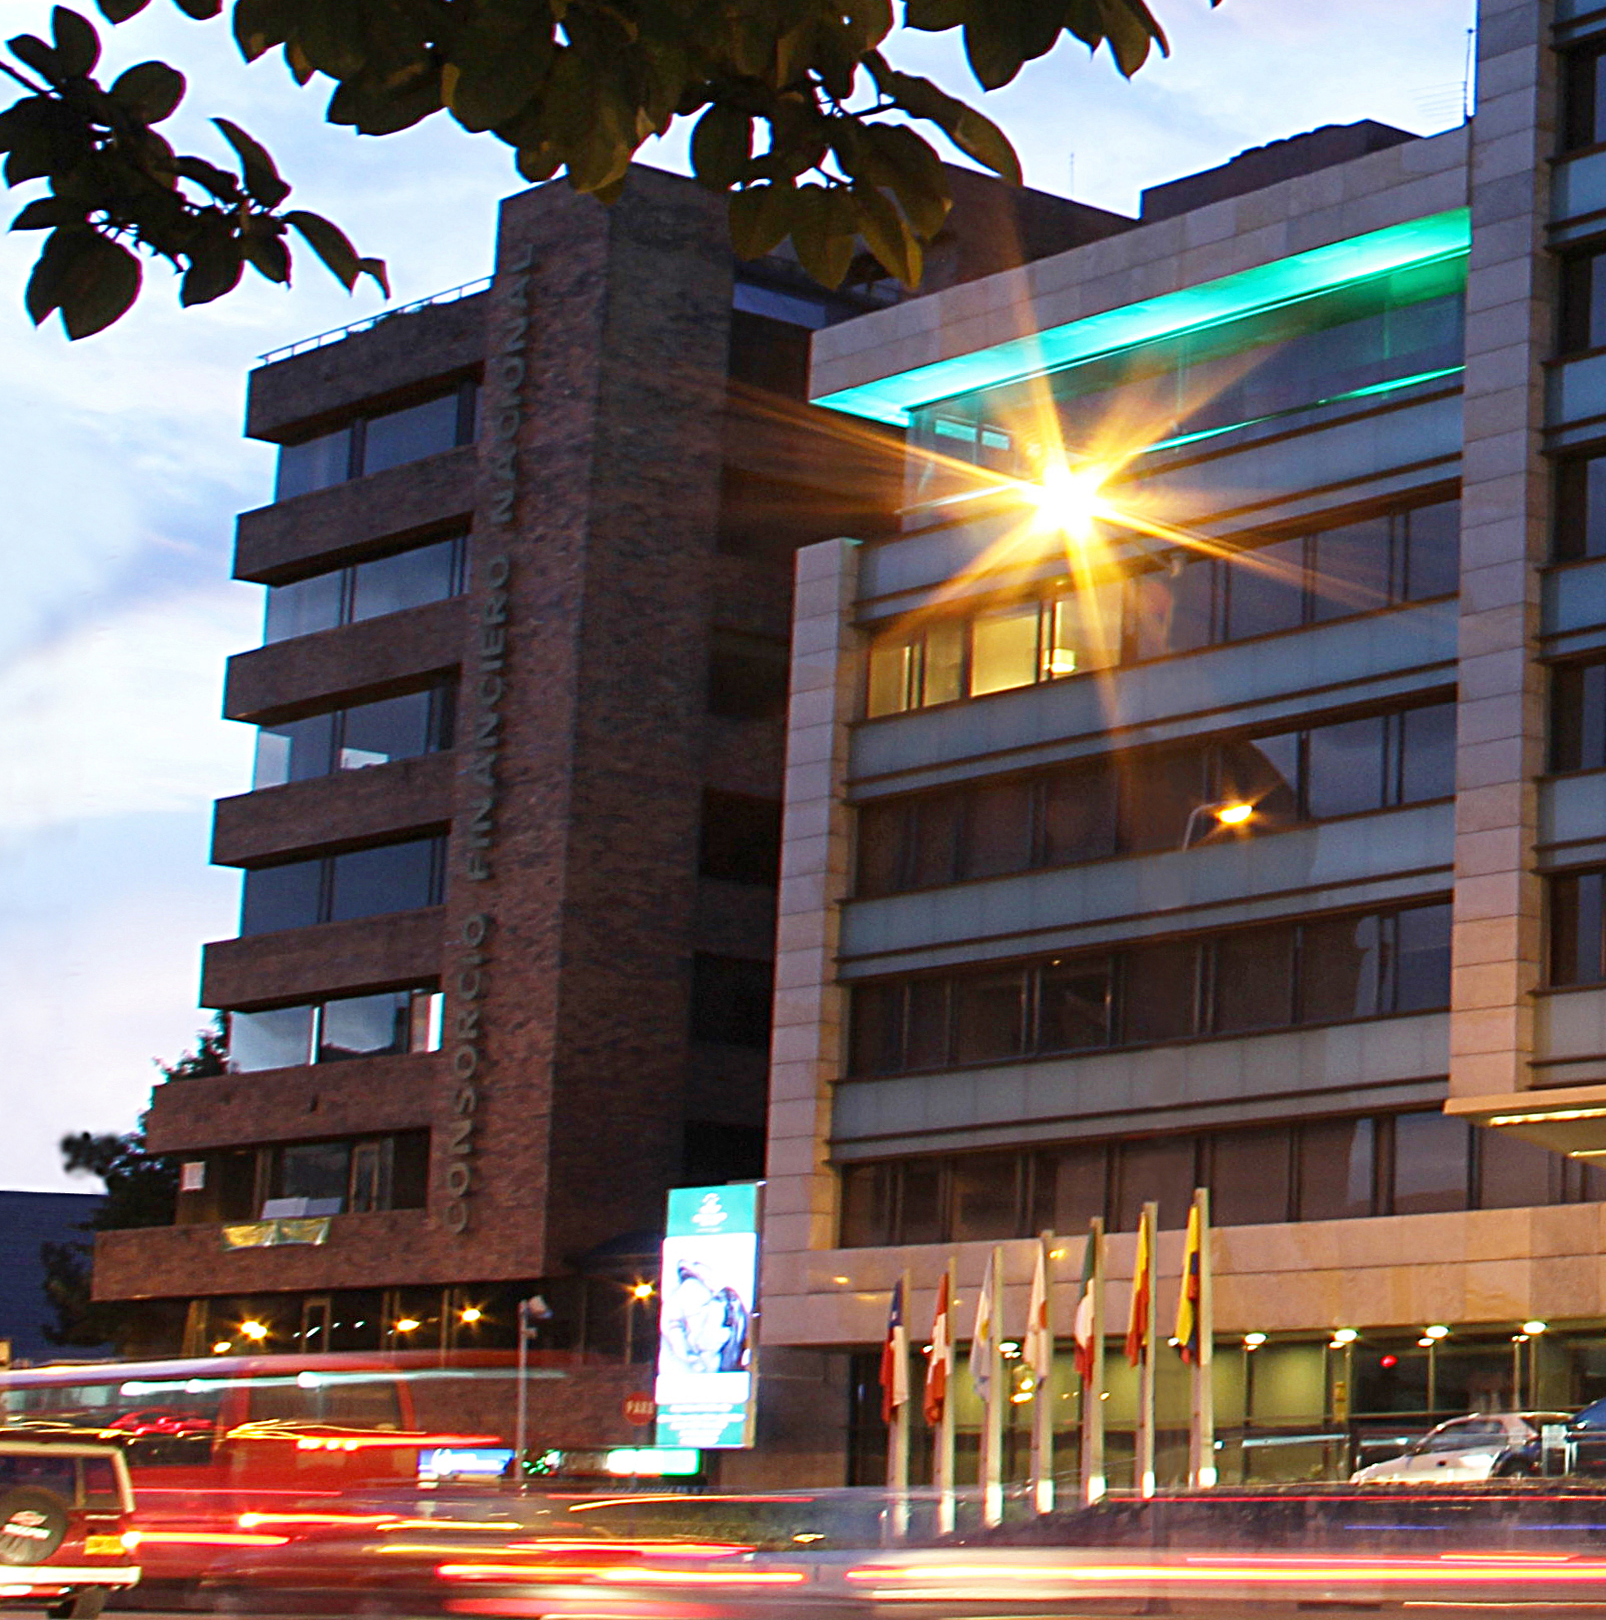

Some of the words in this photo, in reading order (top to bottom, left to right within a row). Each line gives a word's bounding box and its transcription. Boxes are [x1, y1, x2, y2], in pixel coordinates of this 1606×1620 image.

[444, 912, 488, 1235] CONSORCIO
[467, 554, 511, 882] FINANCIERO
[489, 243, 535, 525] NACIONAL
